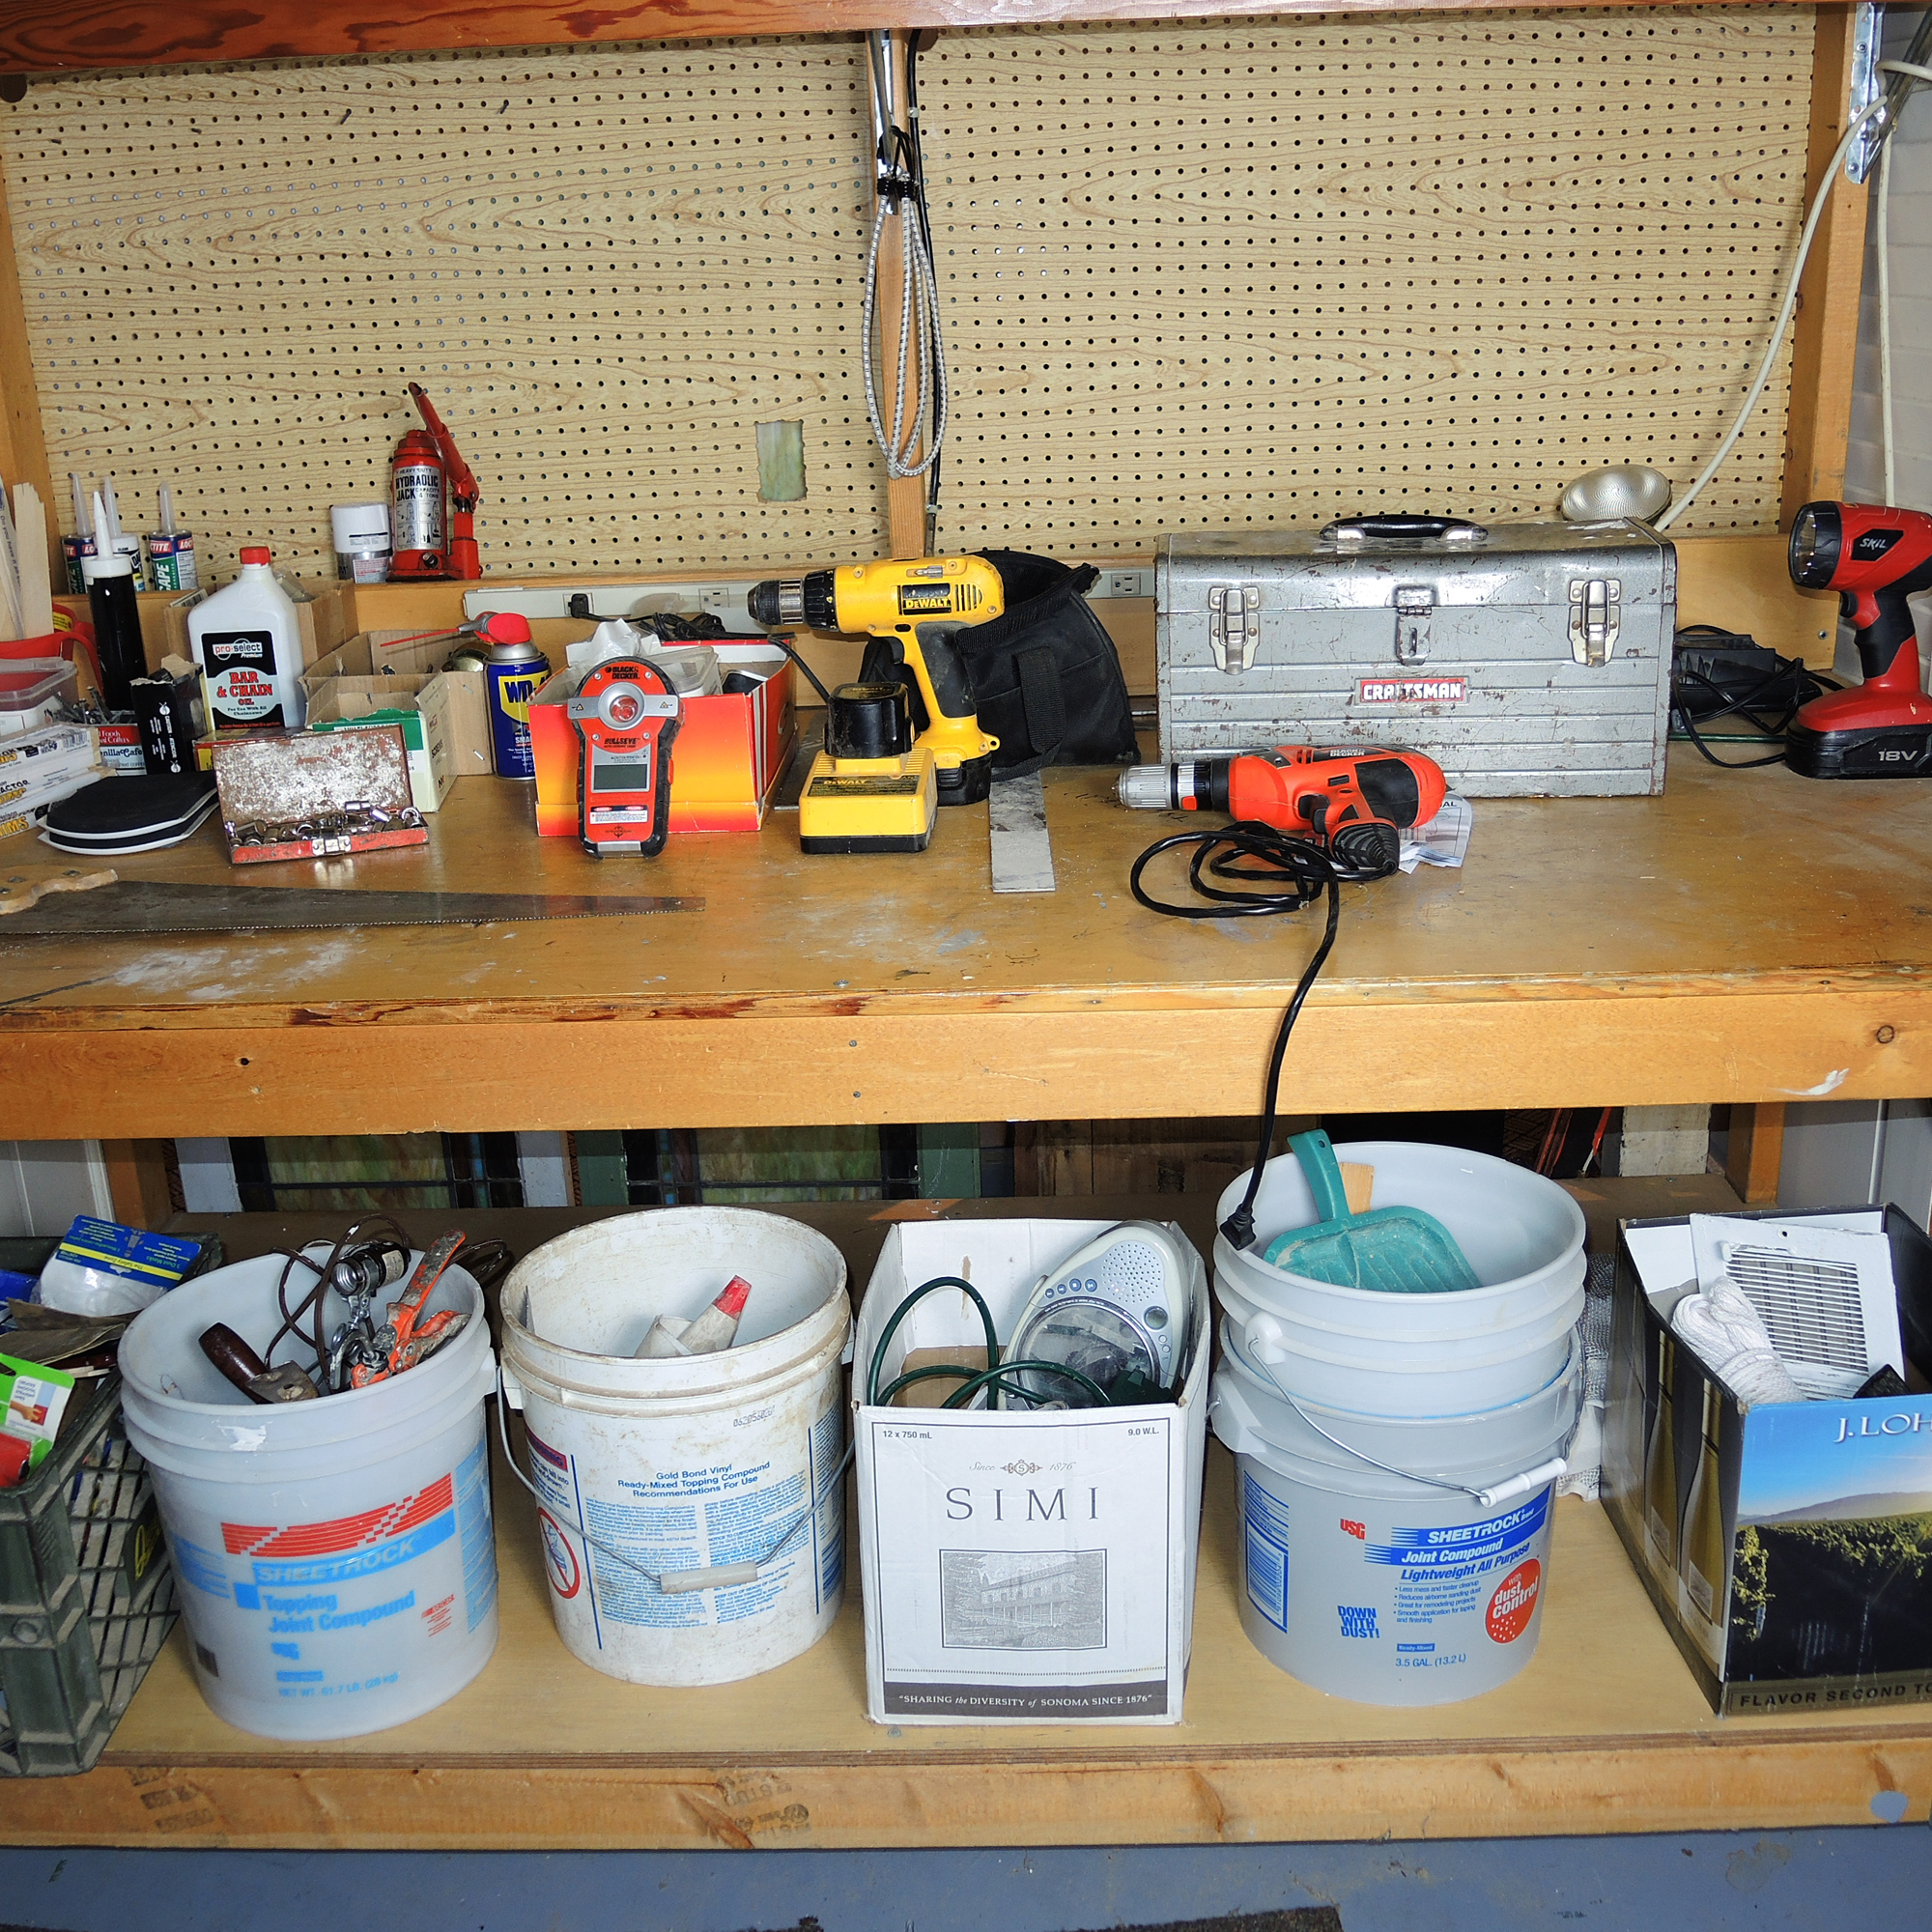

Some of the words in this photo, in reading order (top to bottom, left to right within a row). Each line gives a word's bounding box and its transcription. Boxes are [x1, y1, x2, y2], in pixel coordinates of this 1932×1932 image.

[396, 488, 416, 501] JACK
[1860, 537, 1888, 550] SKIL
[229, 671, 259, 684] BAR
[217, 686, 227, 697] &
[230, 684, 272, 697] CHAIN
[1877, 750, 1918, 761] 18V
[0, 780, 29, 794] ACTOR
[117, 1259, 132, 1267] Safety
[146, 1256, 163, 1264] Masks
[164, 1260, 177, 1268] Dust
[1143, 1427, 1159, 1435] W.L.
[1833, 1417, 1854, 1443] J.
[1861, 1412, 1932, 1436] LOH
[920, 1431, 932, 1439] mL
[656, 1471, 679, 1480] Gold
[682, 1469, 707, 1479] Bond
[710, 1463, 732, 1475] Vinyl
[969, 1461, 996, 1471] Since
[1048, 1461, 1076, 1471] 1876
[617, 1479, 678, 1490] Ready-Mixed
[681, 1476, 719, 1488] Topping
[721, 1461, 771, 1482] Compound
[633, 1486, 721, 1497] Recommendations
[724, 1481, 738, 1490] For
[741, 1475, 758, 1485] Use
[946, 1486, 1099, 1522] SIMI
[1340, 1518, 1366, 1540] USG
[1402, 1551, 1437, 1563] Joint
[1438, 1538, 1504, 1562] Compound
[258, 1537, 414, 1582] SHEETROCK
[1401, 1564, 1476, 1582] Lightweight
[1477, 1560, 1492, 1573] All
[1494, 1542, 1530, 1568] Purpose
[1459, 1580, 1479, 1589] cleanup
[1508, 1573, 1521, 1586] with
[1492, 1576, 1539, 1619] control
[1494, 1581, 1521, 1605] dust
[264, 1594, 338, 1615] Topping
[1456, 1597, 1476, 1605] projects
[269, 1616, 315, 1633] Joint
[319, 1589, 415, 1631] Compound
[1337, 1605, 1377, 1618] DOWN
[1341, 1616, 1375, 1628] WITH
[1341, 1626, 1379, 1638] DUST!
[1412, 1658, 1433, 1667] GAL.
[1435, 1655, 1457, 1667] (13.2
[1459, 1653, 1466, 1663] L)
[970, 1696, 1025, 1707] DIVERSITY
[1027, 1698, 1037, 1709] of
[1040, 1698, 1089, 1707] SONOMA
[1092, 1696, 1123, 1705] SINCE
[1740, 1692, 1816, 1707] FLAVOR
[1826, 1685, 1906, 1702] SECOND
